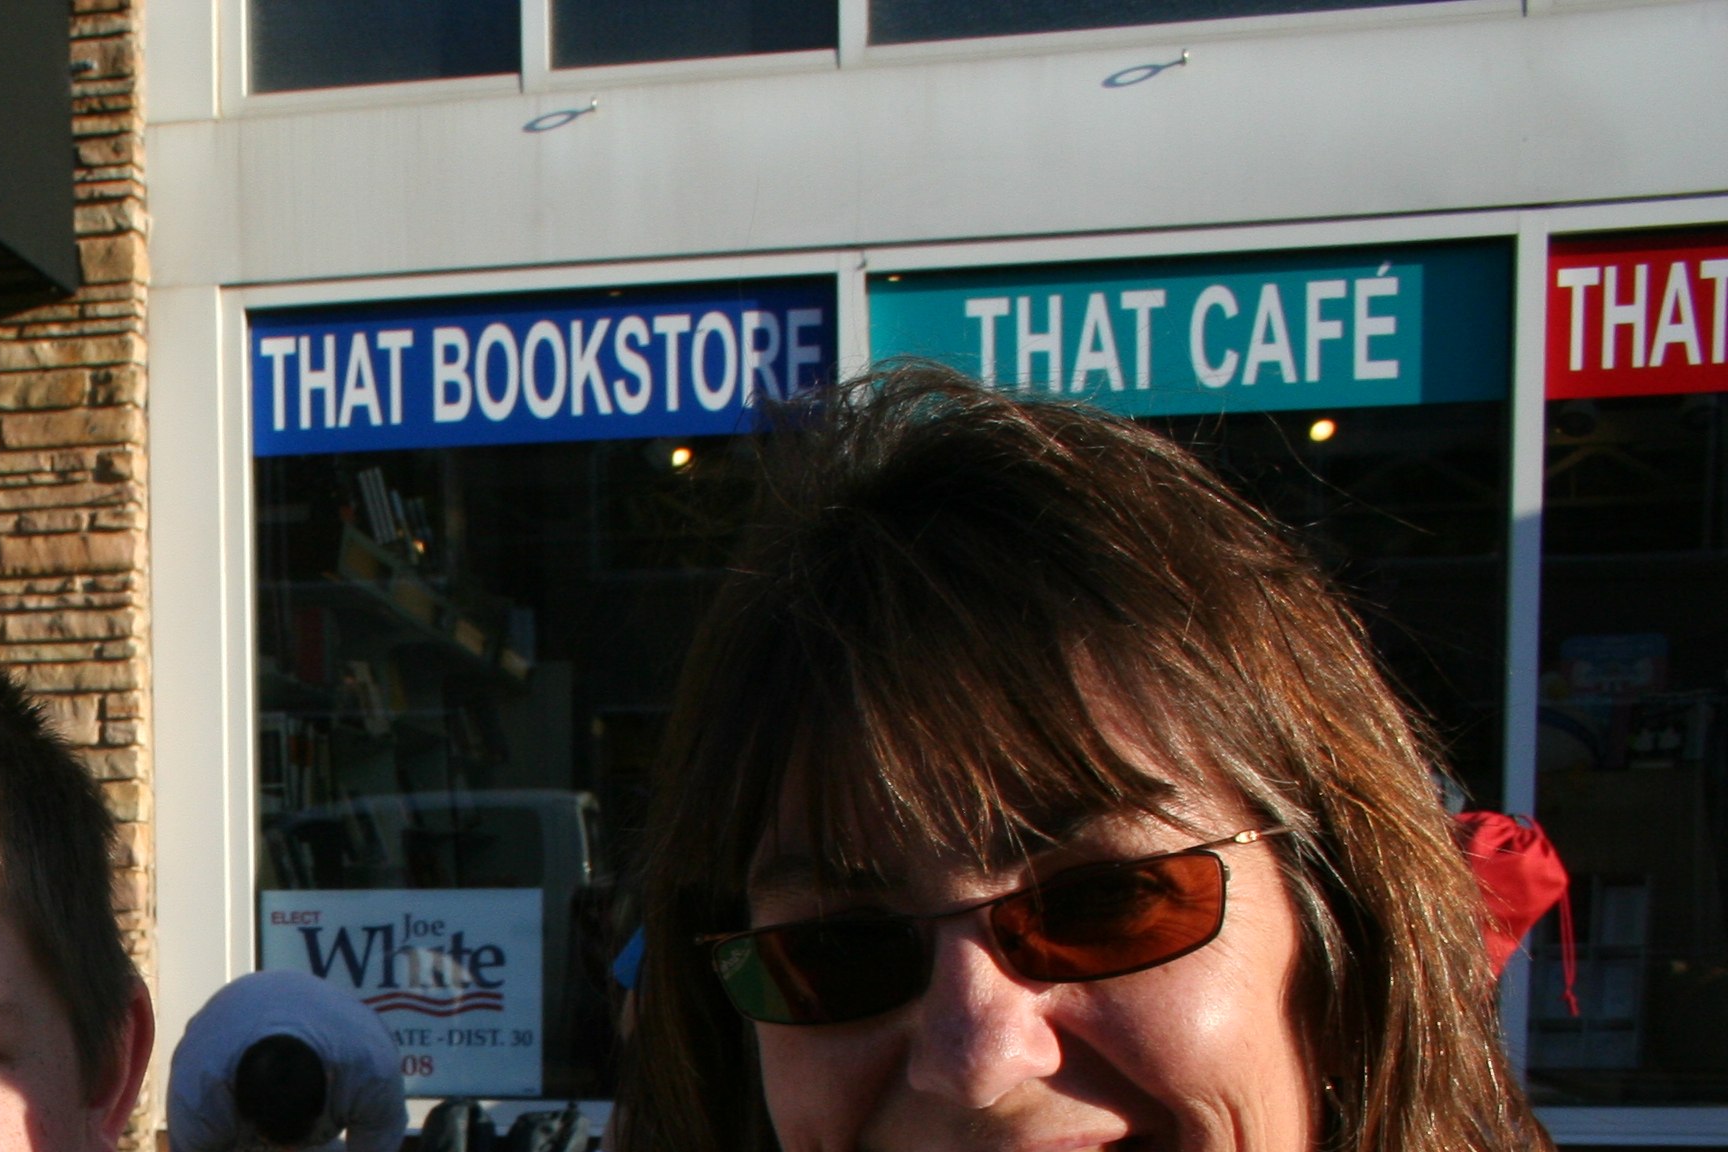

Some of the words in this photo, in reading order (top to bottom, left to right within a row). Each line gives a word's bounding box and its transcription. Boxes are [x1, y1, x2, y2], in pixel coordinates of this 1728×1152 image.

[965, 290, 1168, 394] THAT
[1189, 260, 1400, 390] CAFÉ
[1556, 257, 1728, 373] THAT
[260, 328, 415, 431] THAT
[433, 308, 824, 425] BOOKSTORE
[271, 911, 322, 926] ELECT
[402, 913, 446, 942] Joe
[297, 923, 506, 990] White
[447, 1029, 504, 1047] DIST.
[511, 1029, 534, 1047] 30
